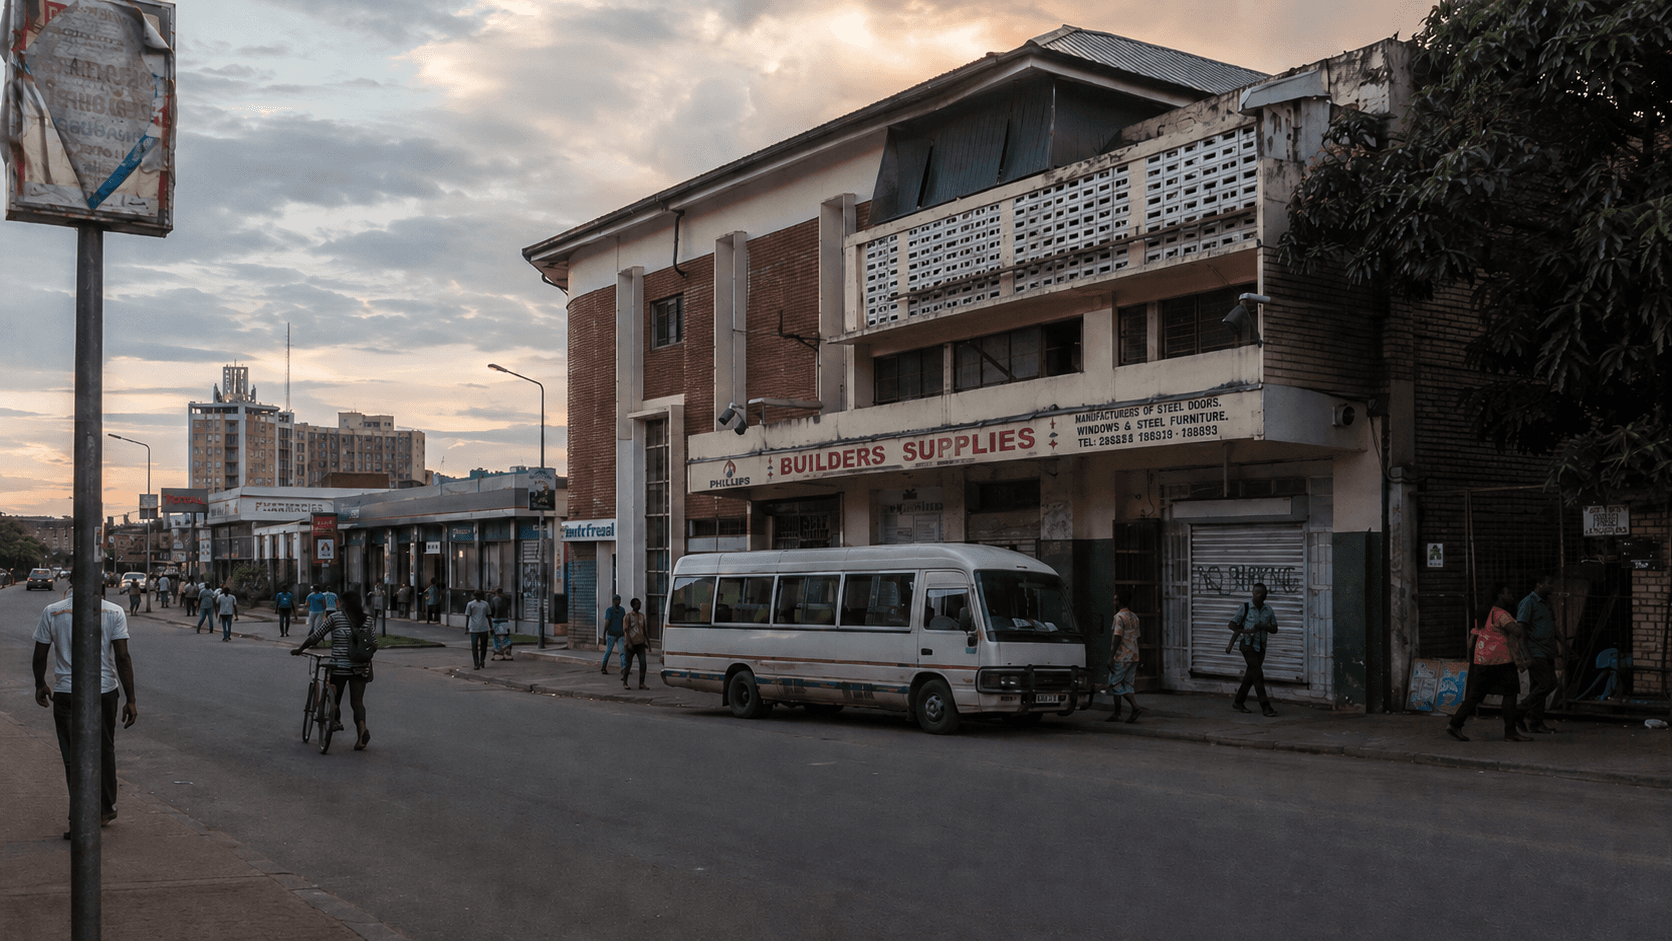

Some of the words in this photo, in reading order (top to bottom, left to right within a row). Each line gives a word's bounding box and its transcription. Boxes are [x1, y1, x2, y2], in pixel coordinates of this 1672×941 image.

[1075, 407, 1140, 424] MANUFACTURERS
[1143, 405, 1154, 416] OF
[1157, 402, 1184, 414] STEEL
[1188, 398, 1222, 410] DOORS.
[1077, 422, 1120, 436] WINDOWS
[1124, 421, 1131, 431] &
[1137, 418, 1165, 430] STEEL
[1170, 411, 1229, 426] FURNITURE.
[780, 445, 886, 476] BUILDERS
[902, 426, 1036, 463] SUPPLIES
[1078, 437, 1096, 448] TEL:
[709, 477, 750, 489] PHILLIPS
